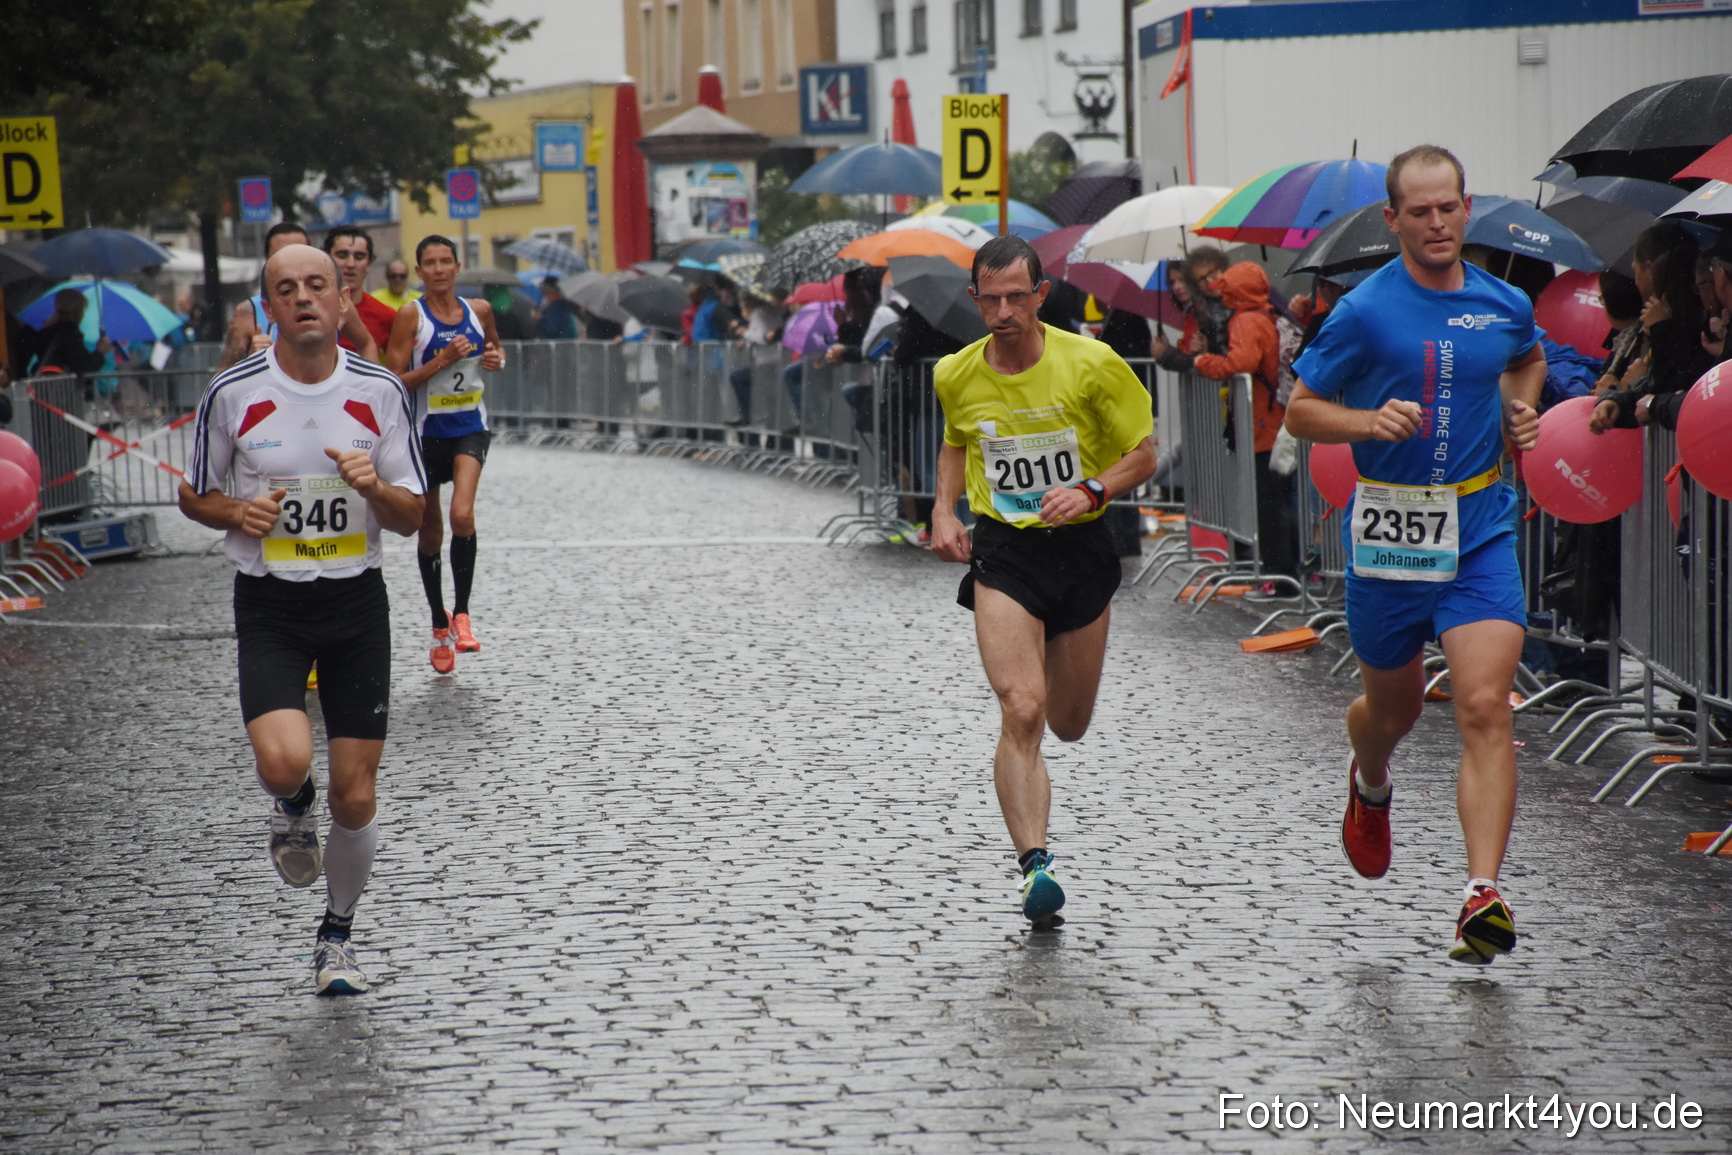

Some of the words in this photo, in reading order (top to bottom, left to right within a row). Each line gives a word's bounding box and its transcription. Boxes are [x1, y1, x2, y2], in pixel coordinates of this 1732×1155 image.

[950, 99, 1001, 118] Block
[960, 128, 992, 180] D
[3, 152, 42, 205] D
[1524, 230, 1551, 243] epp
[1439, 339, 1454, 379] SWIM
[453, 372, 465, 392] 2
[1421, 340, 1437, 405] FINISHER
[1436, 406, 1451, 440] BIKE
[1021, 432, 1069, 449] BOCK
[1434, 441, 1448, 462] 90
[995, 450, 1075, 491] 2010
[1430, 467, 1446, 487] RU
[308, 478, 352, 490] BOC
[282, 497, 348, 535] 346
[1362, 507, 1448, 545] 2357
[295, 542, 338, 558] Martin
[1372, 550, 1437, 568] Johannes
